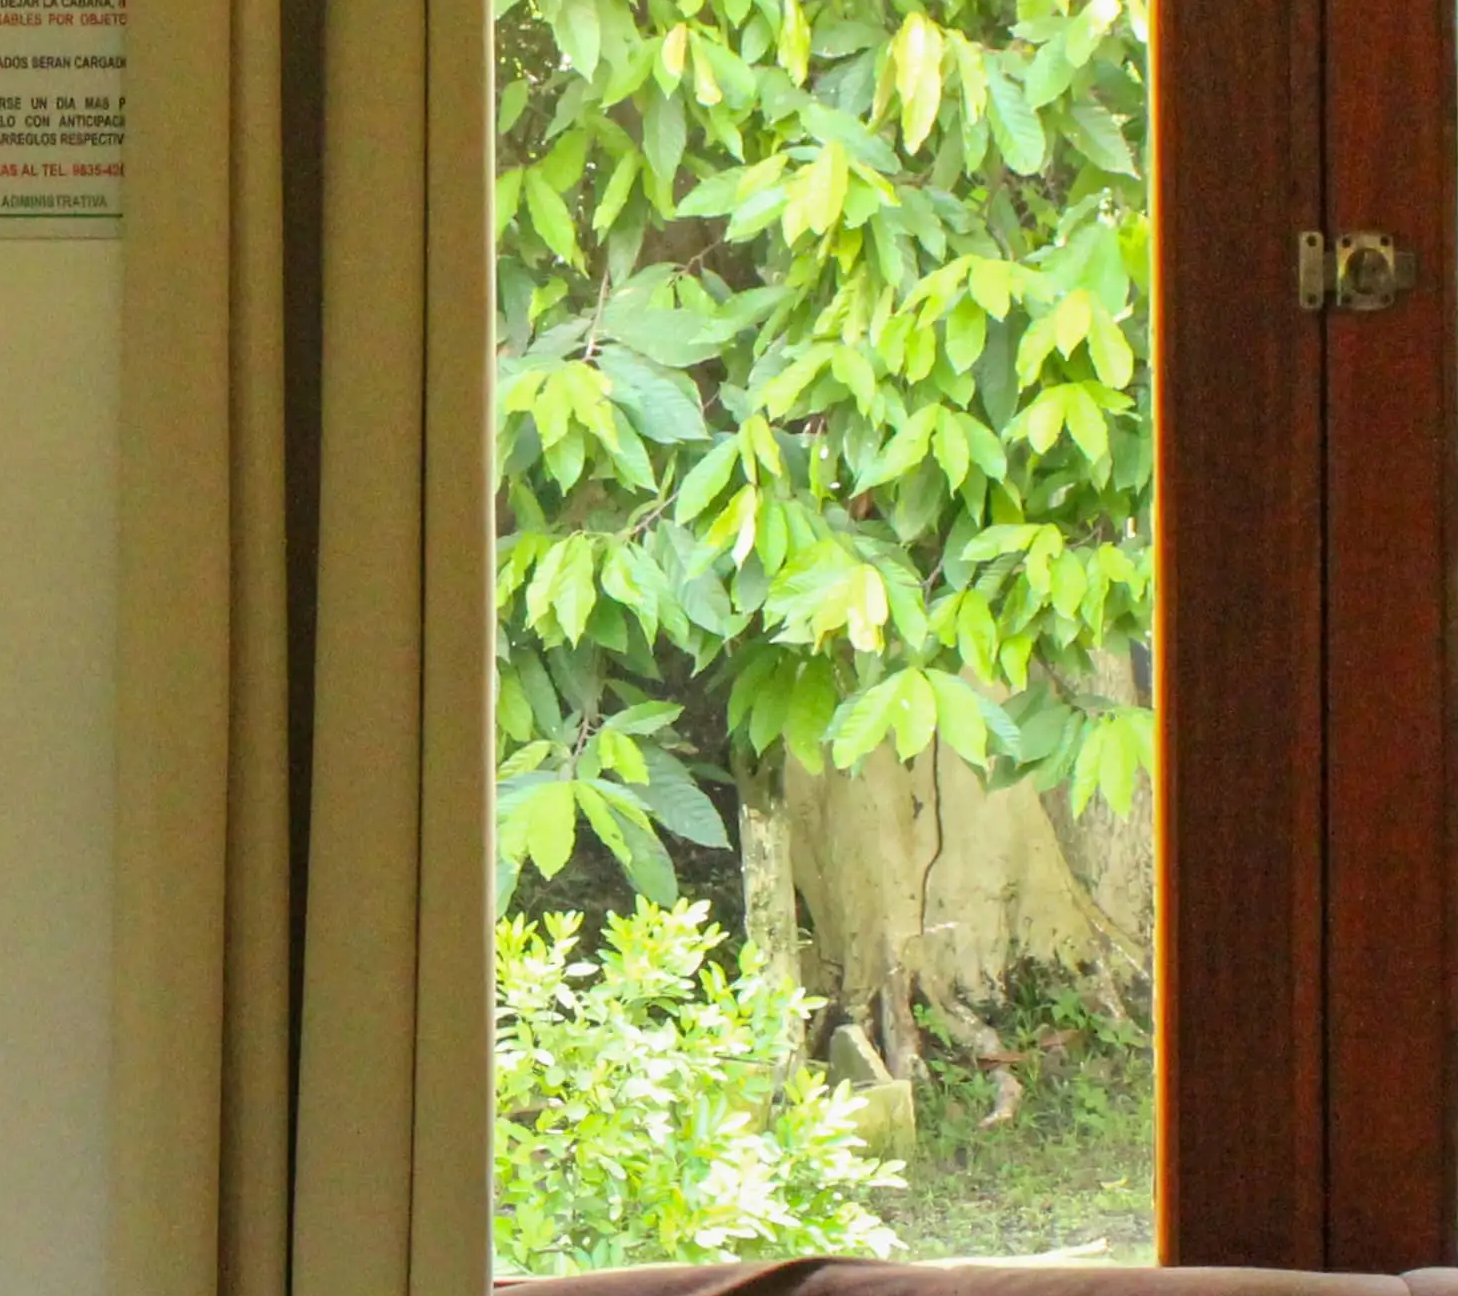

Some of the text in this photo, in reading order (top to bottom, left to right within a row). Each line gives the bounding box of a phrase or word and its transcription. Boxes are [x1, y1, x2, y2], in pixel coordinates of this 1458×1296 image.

[48, 13, 74, 26] POR
[32, 56, 70, 69] SERAN
[31, 97, 47, 110] UN
[24, 115, 50, 128] CON
[21, 163, 38, 177] AL
[2, 195, 107, 208] ADMINISTRATIVA
